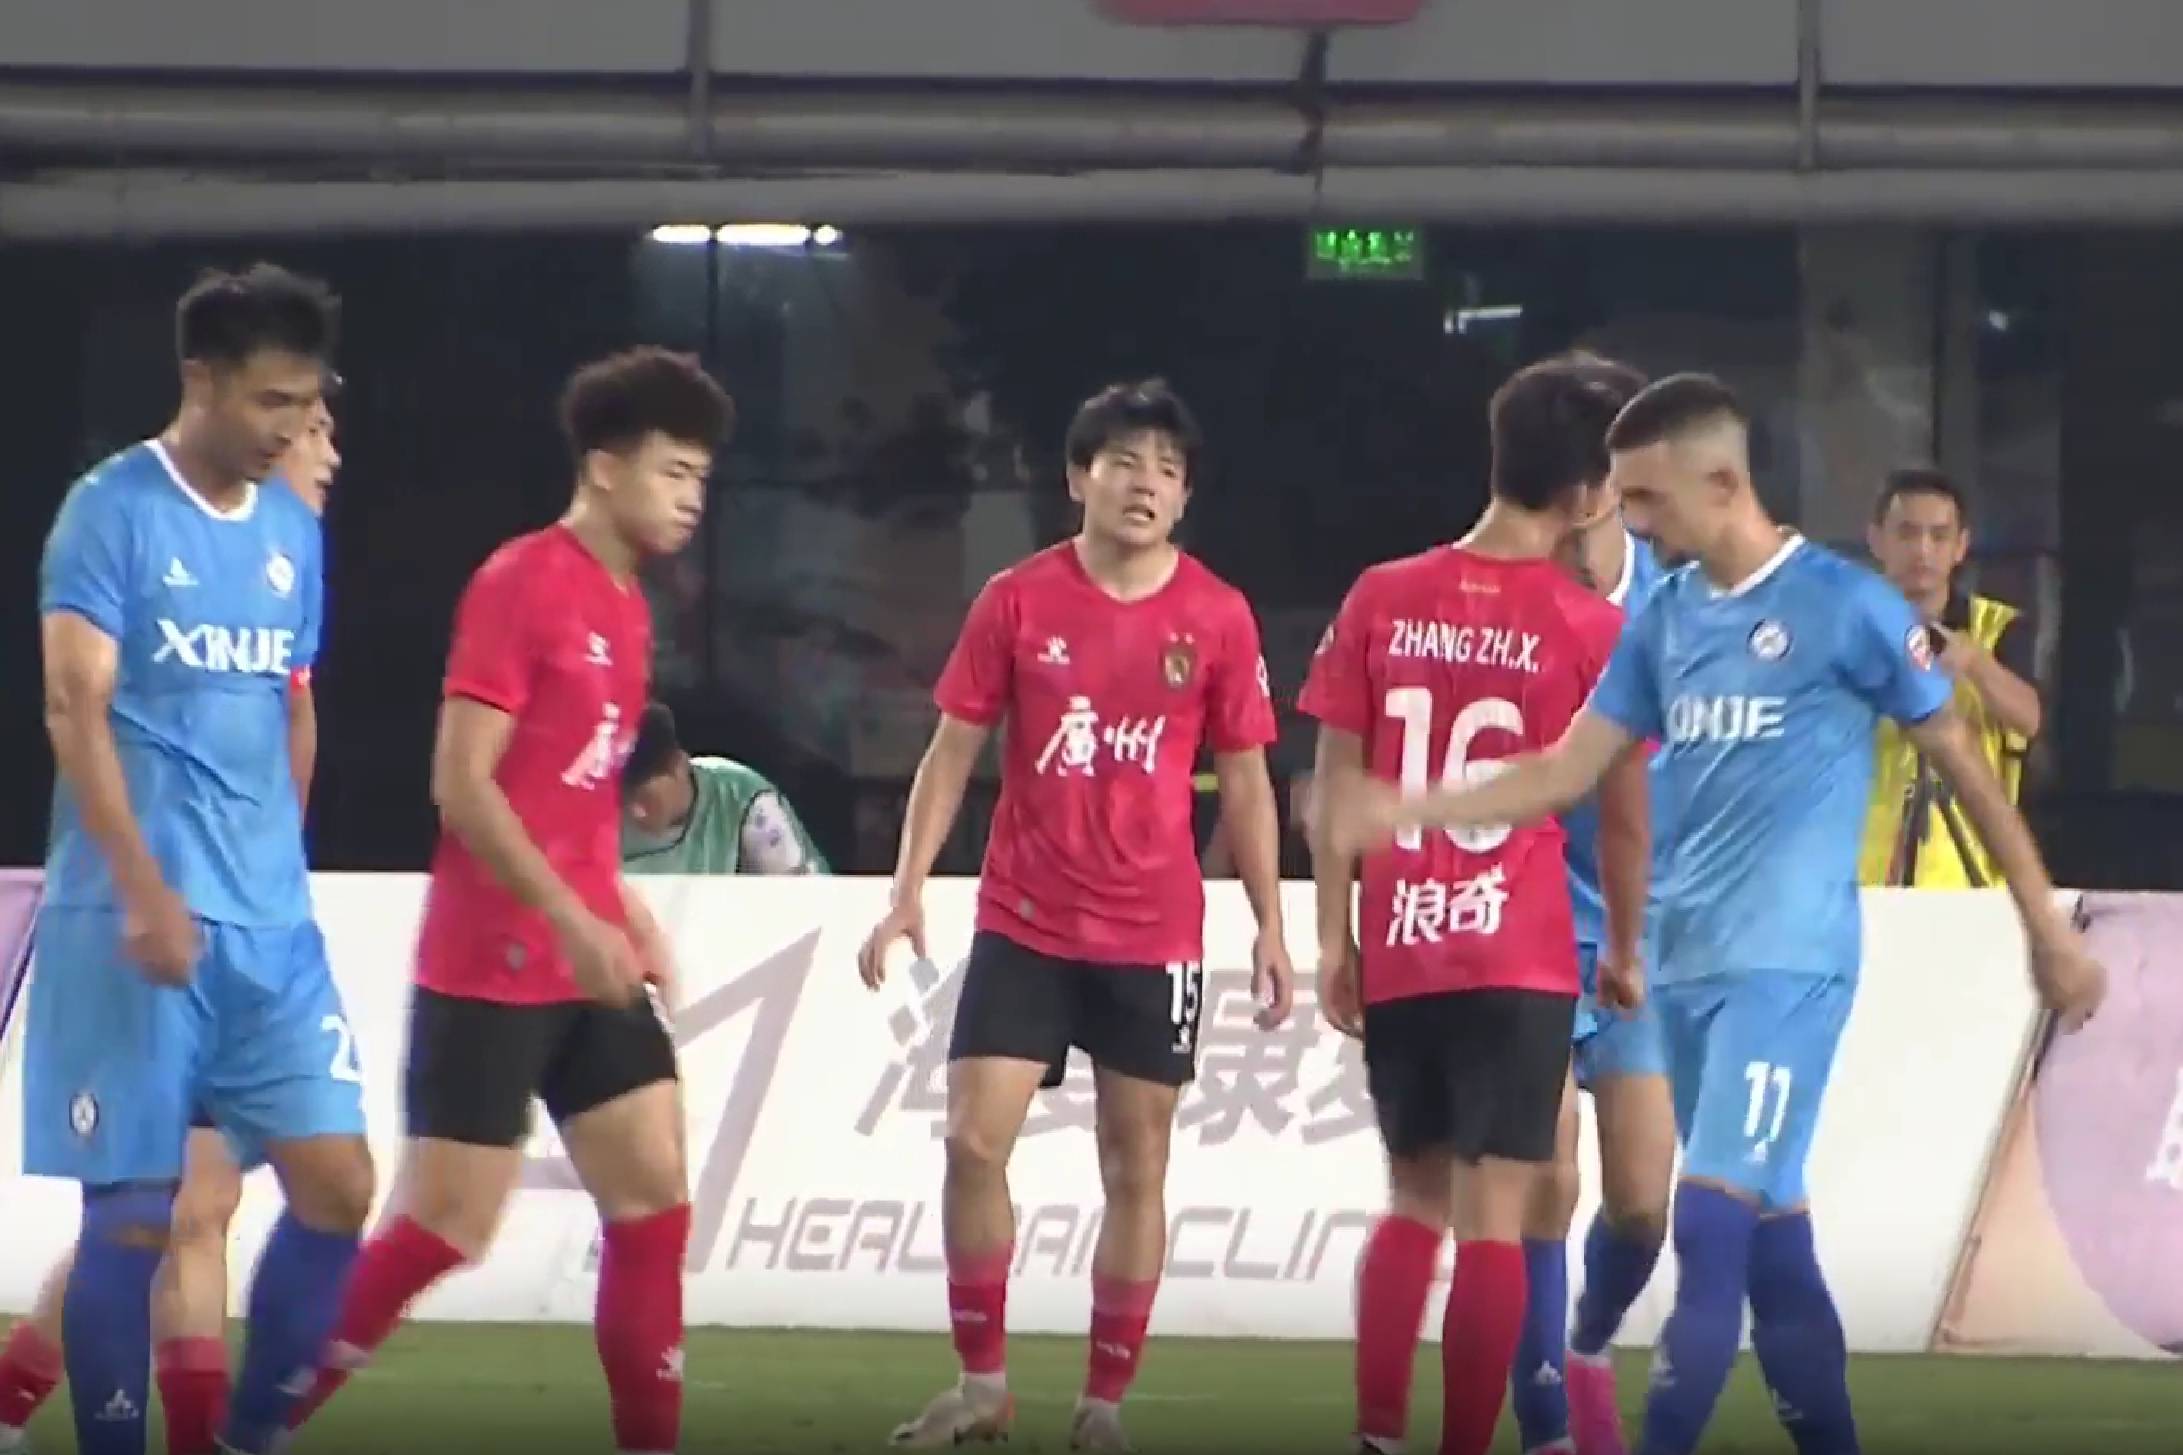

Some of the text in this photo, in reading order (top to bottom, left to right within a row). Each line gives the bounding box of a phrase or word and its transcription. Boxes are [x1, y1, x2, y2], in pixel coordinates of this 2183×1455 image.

[152, 616, 296, 674] XINJE
[1388, 618, 1475, 662] ZHANG
[1476, 626, 1543, 673] ZH.X.
[1034, 695, 1166, 777] 廣州
[1384, 686, 1525, 853] 16
[1386, 862, 1510, 947] 浪奇
[1165, 961, 1200, 1024] 15
[1744, 1061, 1791, 1142] 11
